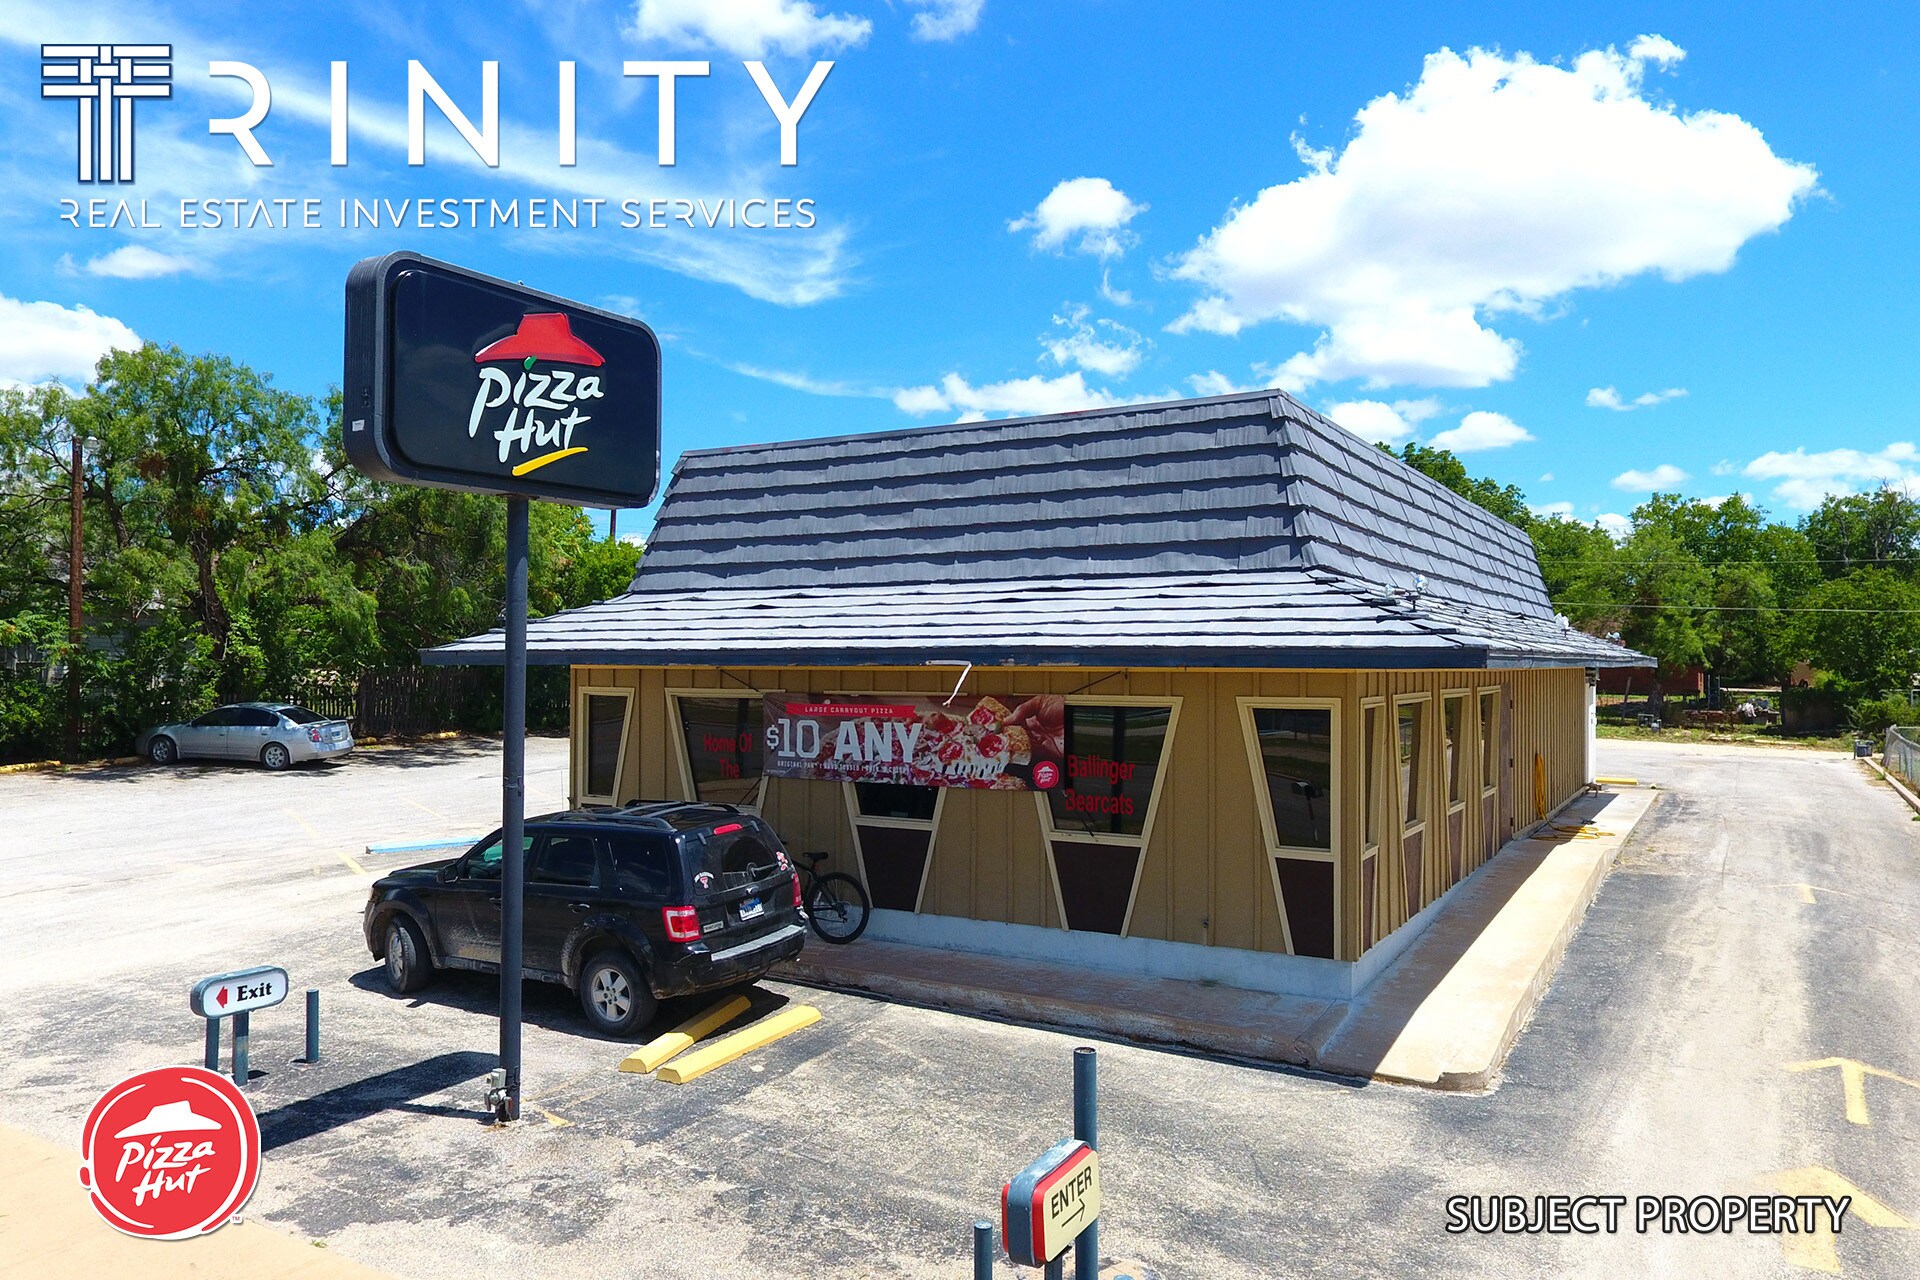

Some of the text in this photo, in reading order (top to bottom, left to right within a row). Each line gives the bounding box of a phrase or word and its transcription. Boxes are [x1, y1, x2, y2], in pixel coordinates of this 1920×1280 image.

[468, 356, 604, 438] Pizza
[493, 407, 592, 463] Hut
[703, 733, 736, 753] Home
[766, 718, 923, 763] $10 ANY
[719, 758, 740, 782] The
[1067, 754, 1136, 785] Ballinger
[1065, 788, 1135, 815] Bearcats
[236, 982, 272, 1002] Exit
[1051, 1165, 1093, 1220] ENTER
